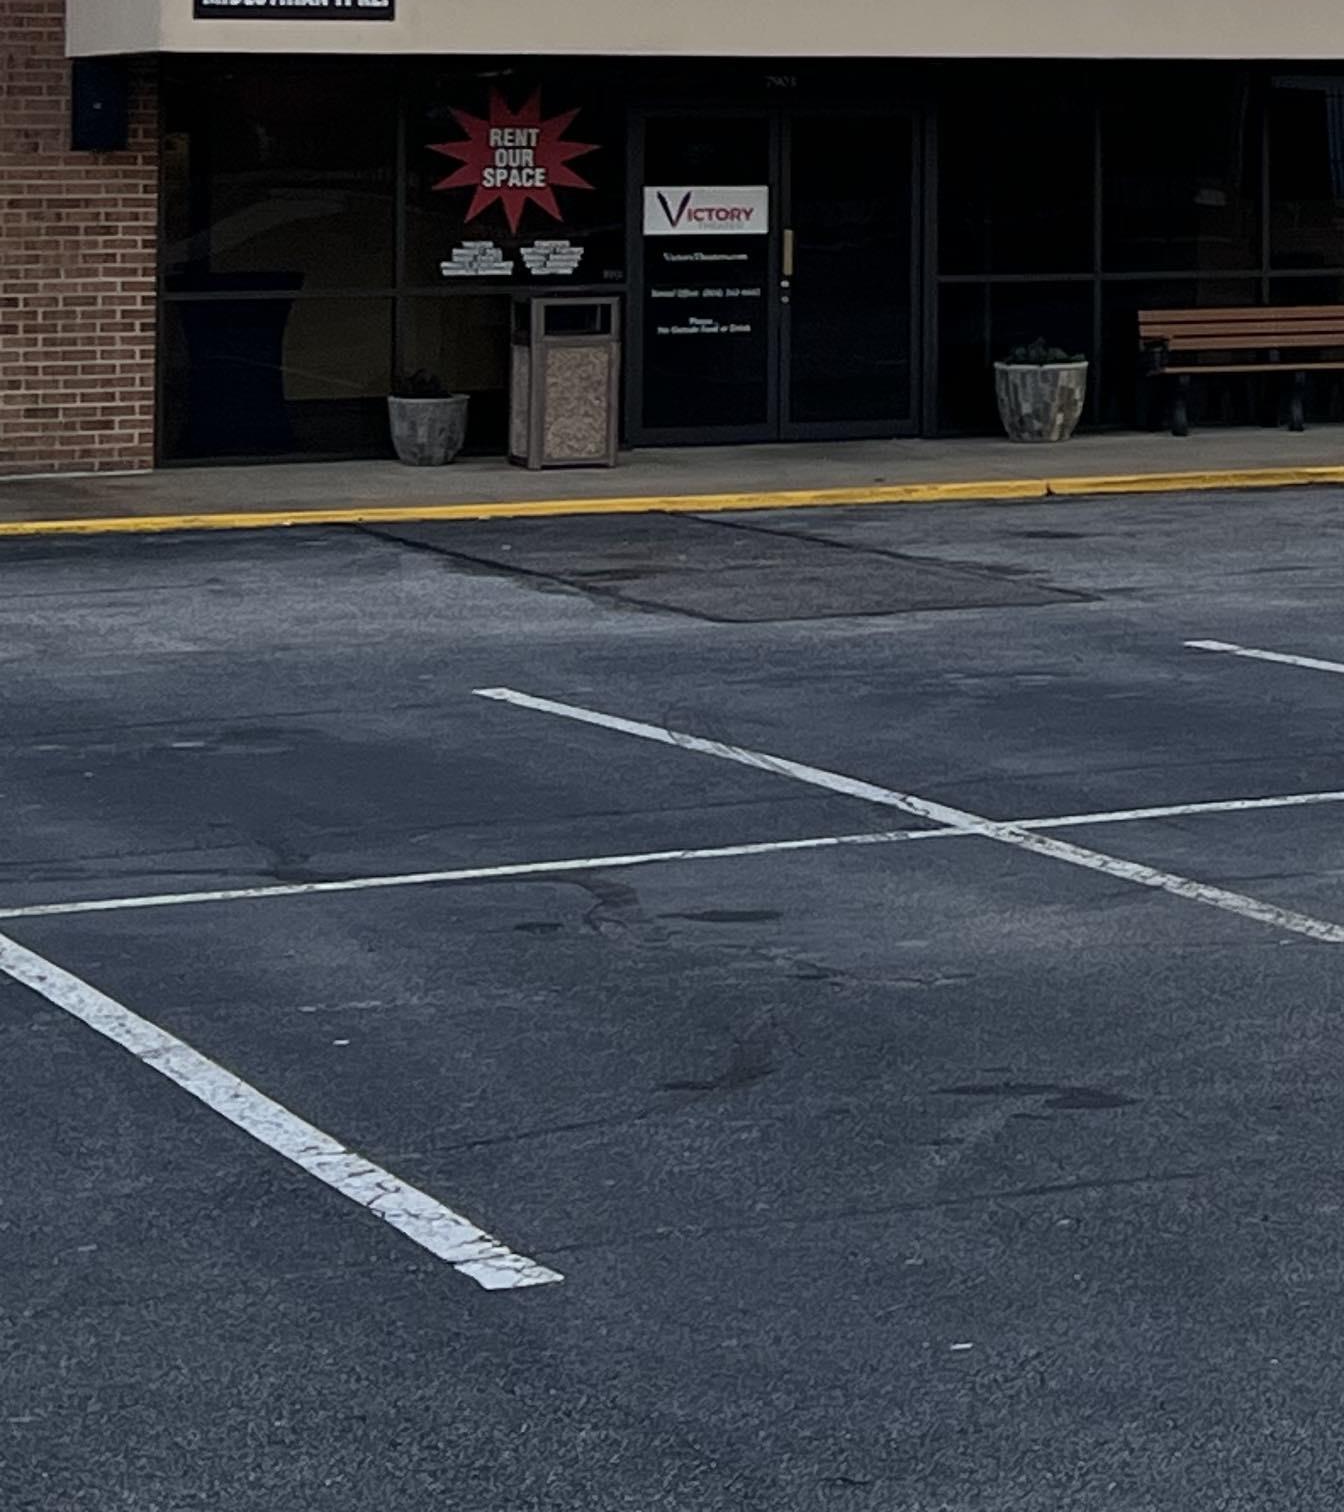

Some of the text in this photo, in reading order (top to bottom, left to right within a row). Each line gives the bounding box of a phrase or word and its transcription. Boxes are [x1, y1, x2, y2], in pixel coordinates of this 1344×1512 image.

[488, 128, 540, 147] RENT
[494, 148, 535, 167] OUR
[481, 167, 547, 188] SPACE
